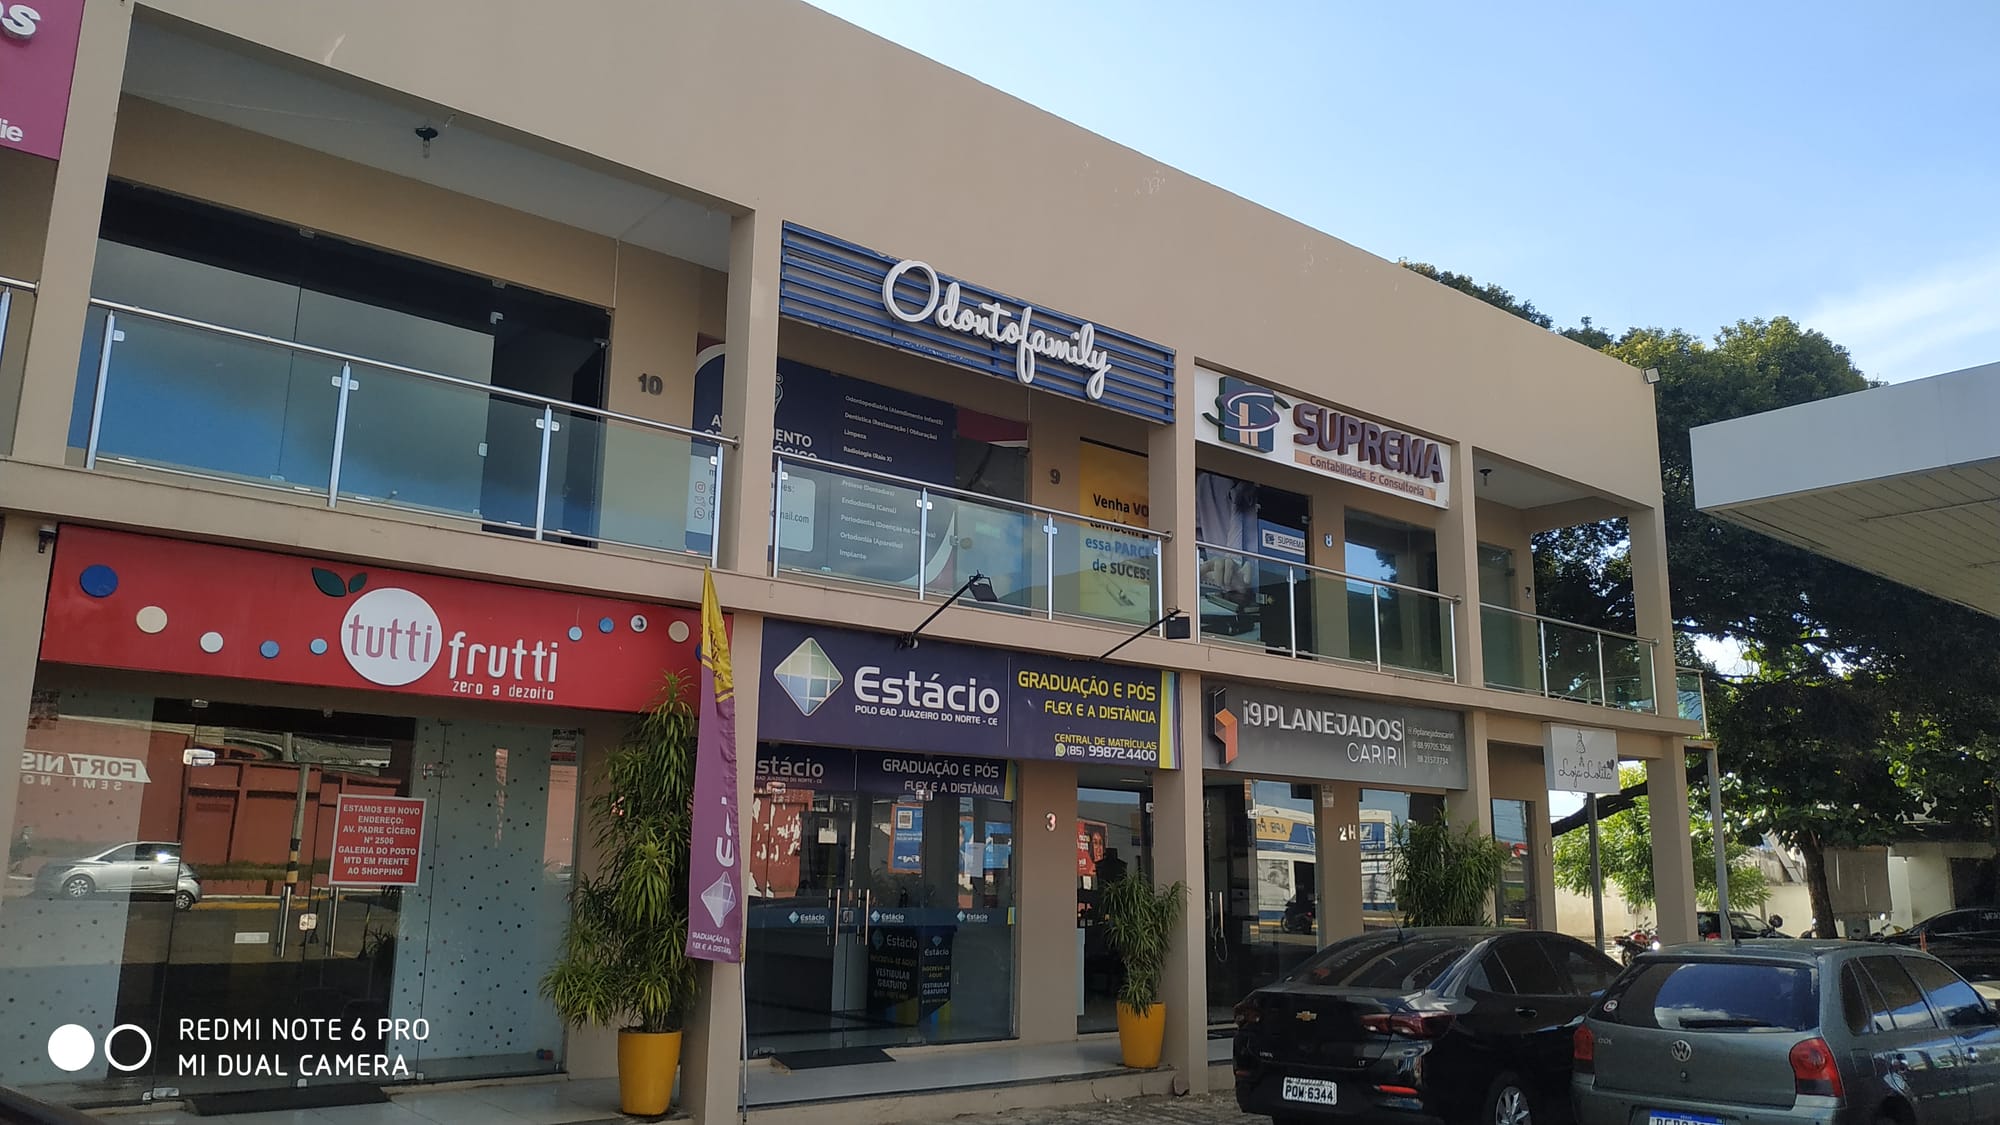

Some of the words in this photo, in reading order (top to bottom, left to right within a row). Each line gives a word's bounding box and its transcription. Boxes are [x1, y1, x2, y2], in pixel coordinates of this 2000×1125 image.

[882, 259, 1112, 400] Odontofamily
[638, 373, 663, 396] 10
[1293, 402, 1445, 483] SUPREMA
[1050, 468, 1061, 485] 9
[1310, 455, 1367, 481] Contabilidade
[1369, 472, 1377, 482] &
[1378, 475, 1425, 497] Consultoria
[1093, 493, 1130, 513] Venha
[1085, 537, 1111, 552] essa
[1277, 535, 1304, 549] SUPREMA
[1325, 534, 1333, 547] 8
[1092, 558, 1107, 573] de
[349, 614, 433, 663] tutti
[448, 631, 558, 683] frutti
[452, 680, 483, 695] zero
[492, 685, 501, 696] a
[508, 684, 554, 701] dezoito
[854, 666, 1000, 714] Estácio
[1018, 671, 1109, 699] GRADUAÇÃO
[1113, 682, 1123, 697] E
[1127, 681, 1156, 701] PÓS
[855, 704, 878, 716] POLO
[879, 707, 898, 717] EAD
[898, 708, 939, 721] JUAZEIRO
[941, 713, 953, 722] DO
[955, 714, 981, 725] NORTE
[988, 717, 998, 726] CE
[1045, 700, 1073, 716] FLEX
[1076, 704, 1084, 716] E
[1087, 705, 1096, 718] A
[1100, 705, 1156, 724] DISTÂNCIA
[1055, 733, 1092, 746] CENTRAL
[1094, 736, 1106, 746] DE
[1108, 736, 1157, 750] MATRÍCULAS
[1067, 745, 1085, 758] (85)
[1347, 743, 1401, 766] CARIRI
[882, 759, 959, 778] GRADUAÇÃO
[963, 764, 970, 776] E
[975, 762, 999, 778] PÓS
[1559, 758, 1582, 788] Loja
[1584, 760, 1612, 780] Lolita
[904, 780, 928, 792] FLEX
[931, 782, 938, 792] E
[940, 782, 948, 793] A
[951, 781, 999, 795] DISTÂNCIA
[343, 804, 382, 814] ESTAMOS
[384, 806, 396, 814] EM
[398, 807, 420, 815] NOVO
[358, 816, 404, 826] ENDEREÇO:
[1046, 813, 1056, 831] 3
[343, 825, 355, 833] AV.
[358, 826, 384, 834] PADRE
[386, 825, 416, 835] CÍCERO
[338, 846, 374, 854] GALERIA
[390, 847, 416, 855] POSTO
[364, 857, 376, 865] EM
[347, 867, 359, 875] AO
[361, 867, 403, 876] SHOPPING
[800, 913, 825, 922] Estácio
[881, 913, 904, 921] Estácio
[966, 913, 988, 921] Estácio
[886, 934, 918, 949] Estácio
[925, 948, 949, 956] Estácio
[875, 967, 911, 981] VESTIBULAR
